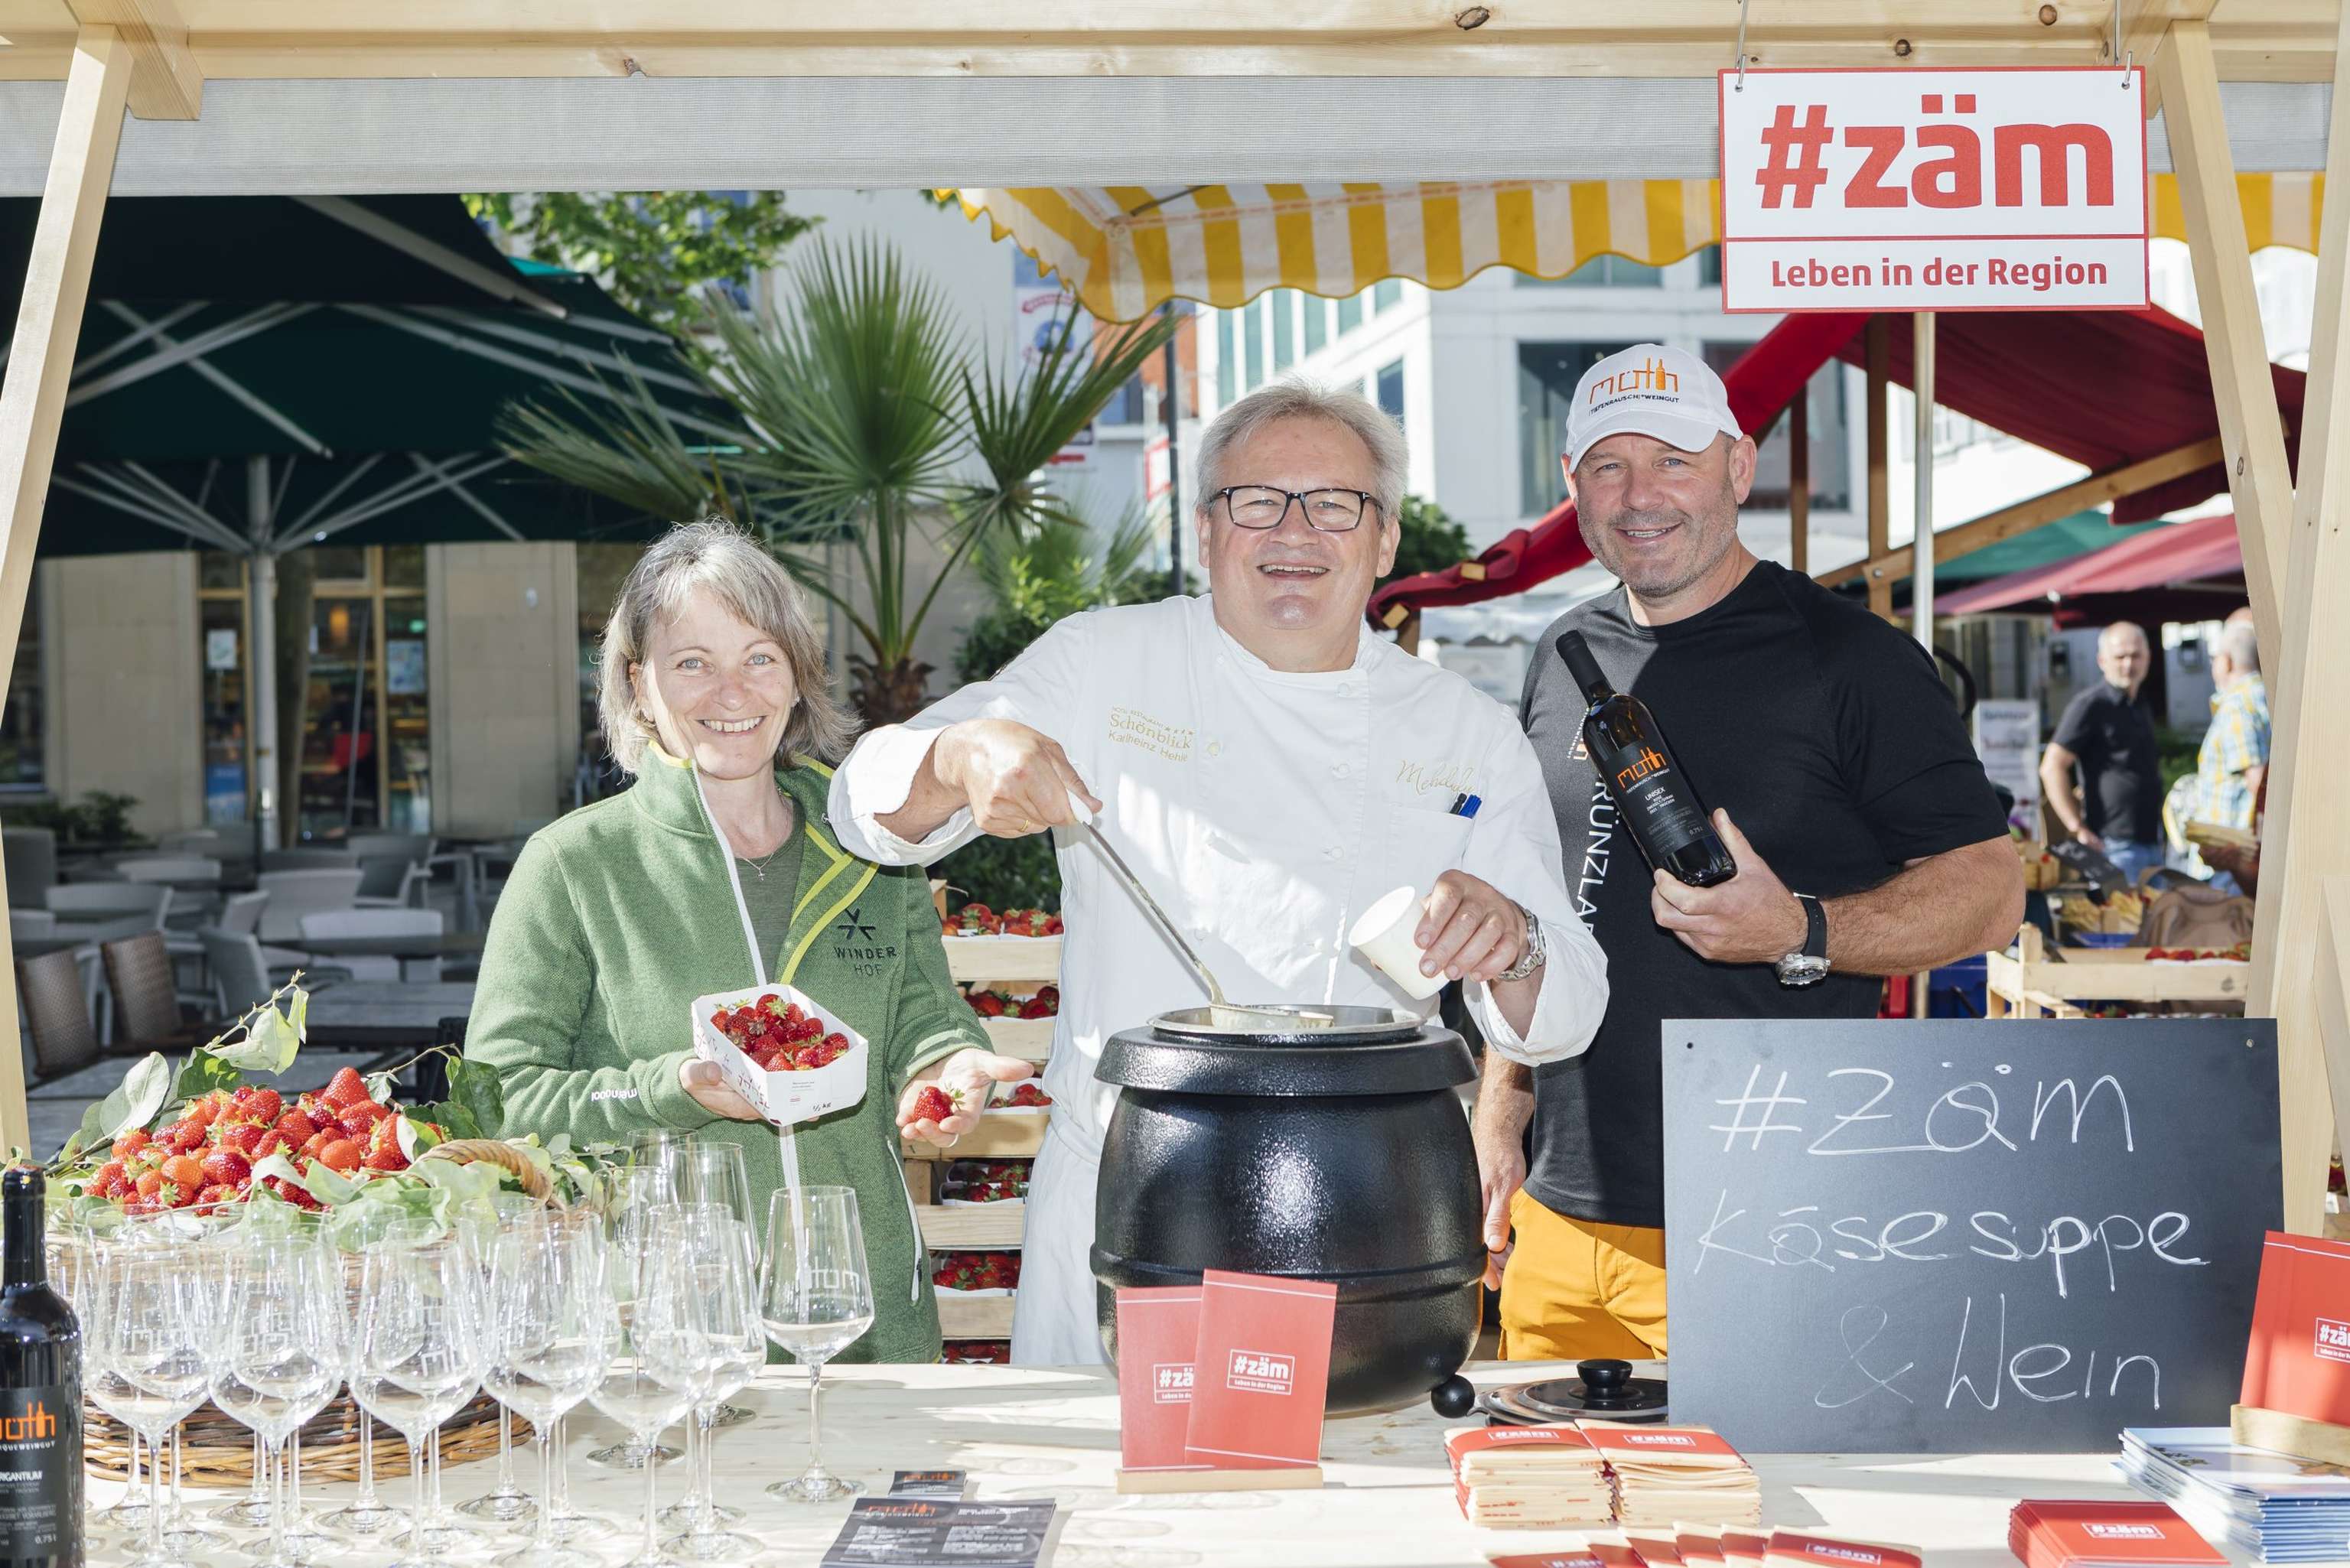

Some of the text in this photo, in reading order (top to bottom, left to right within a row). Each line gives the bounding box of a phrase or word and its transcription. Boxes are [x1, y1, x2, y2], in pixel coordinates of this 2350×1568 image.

[1756, 93, 2114, 209] #zäm
[1772, 255, 2108, 292] Leben in der Region
[1109, 713, 1191, 749] Schönblick
[1645, 786, 1665, 801] UNISEX
[1577, 771, 1620, 935] RÜNZLA
[833, 946, 897, 959] WINDER
[854, 964, 882, 976] HOF
[2319, 1324, 2350, 1348] #zä
[1233, 1355, 1290, 1380] #zäm
[1814, 1293, 2162, 1412] & Wein
[1159, 1367, 1193, 1388] #zä
[0, 1400, 56, 1441] öth
